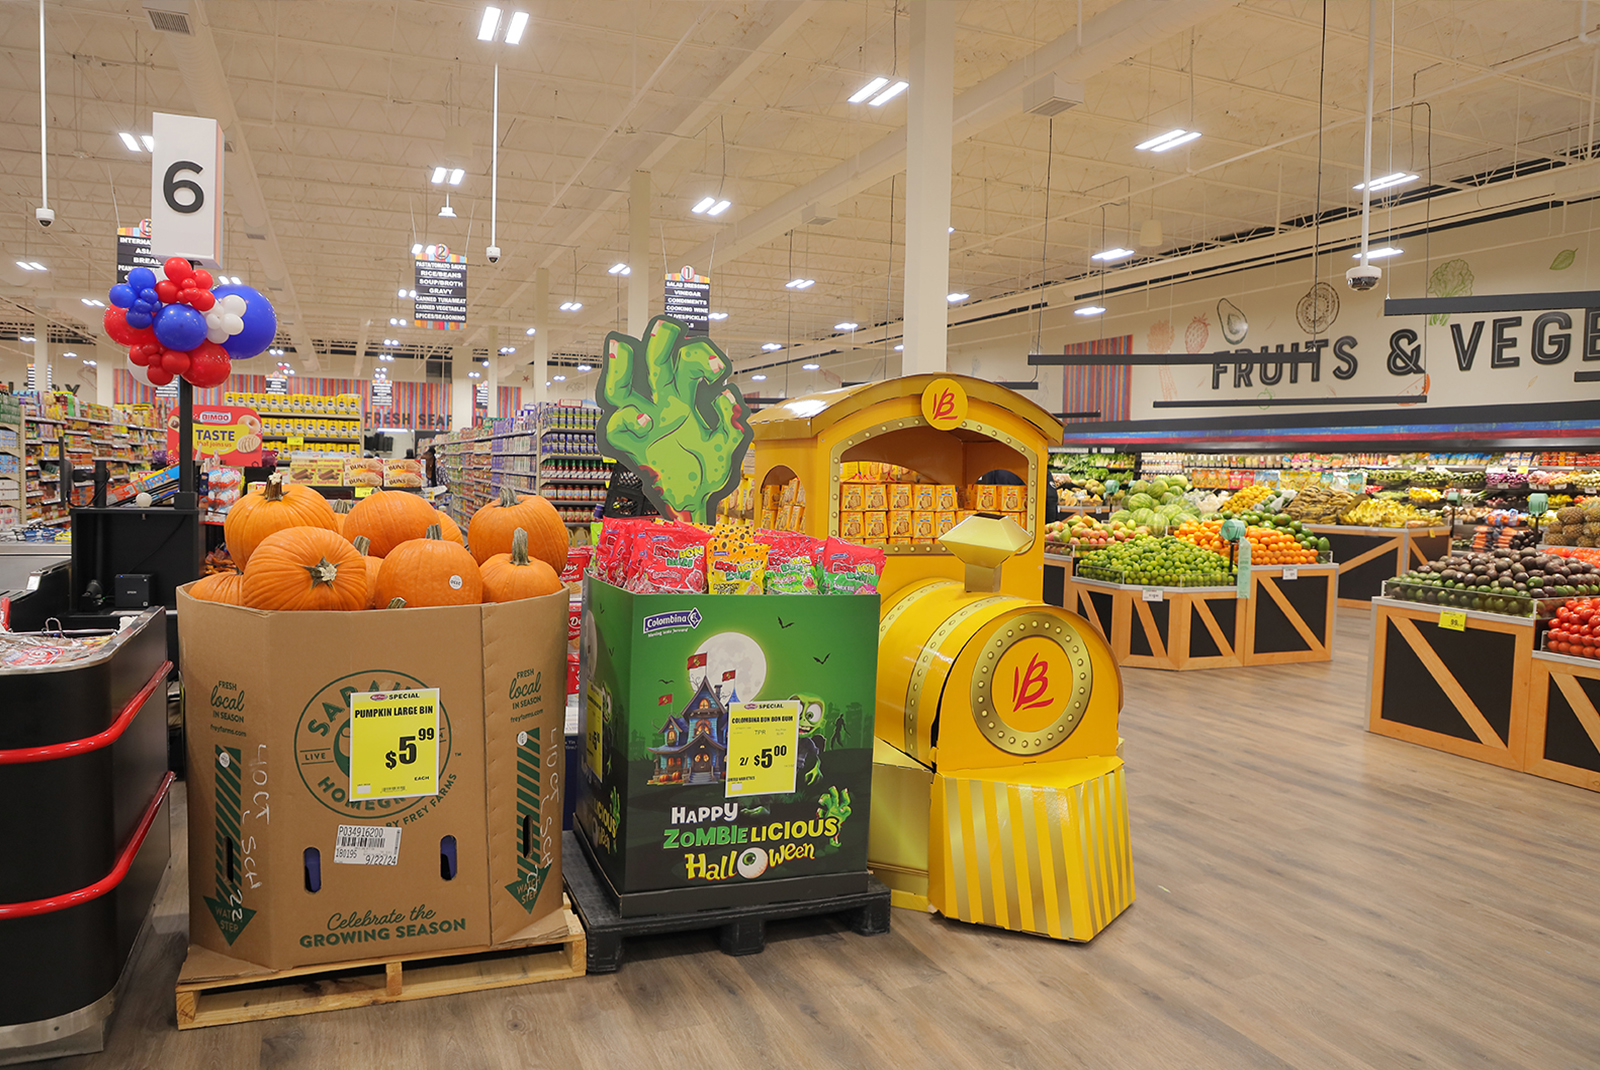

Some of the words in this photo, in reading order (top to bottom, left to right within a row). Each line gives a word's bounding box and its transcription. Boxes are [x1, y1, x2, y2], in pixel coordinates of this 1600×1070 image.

[163, 160, 205, 213] 6
[438, 246, 445, 258] 2
[420, 270, 462, 279] RICE/BEANS
[419, 279, 463, 287] SOUP/BROTH
[1212, 335, 1358, 390] FRUITS
[1386, 328, 1426, 377] &
[202, 414, 229, 422] BIMBO
[365, 412, 410, 425] FRESH
[196, 430, 235, 441] TASTE
[654, 545, 679, 559] BON
[679, 546, 704, 558] BON
[714, 560, 737, 572] BON
[647, 613, 687, 628] Colombina
[517, 668, 535, 679] FRESH
[218, 680, 237, 691] FRESH
[509, 671, 542, 700] local
[210, 685, 245, 712] local
[388, 692, 420, 700] SPECIAL
[512, 702, 519, 710] IN
[520, 695, 542, 708] SEASON
[220, 711, 244, 723] SEASON
[355, 708, 392, 719] PUMPKIN
[394, 706, 418, 716] LARGE
[419, 705, 433, 714] BIN
[732, 716, 760, 724] COLOMBINA
[305, 752, 327, 761] LIVE
[402, 806, 430, 825] FREY
[430, 773, 457, 807] FARMS
[671, 803, 739, 825] HAPPY
[338, 825, 384, 838] P034916200
[365, 854, 397, 866] 9/22/24
[327, 909, 406, 932] Celebrate
[409, 904, 436, 921] the
[220, 919, 239, 933] STEP
[300, 927, 391, 949] GROWING
[395, 918, 466, 940] SEASON
